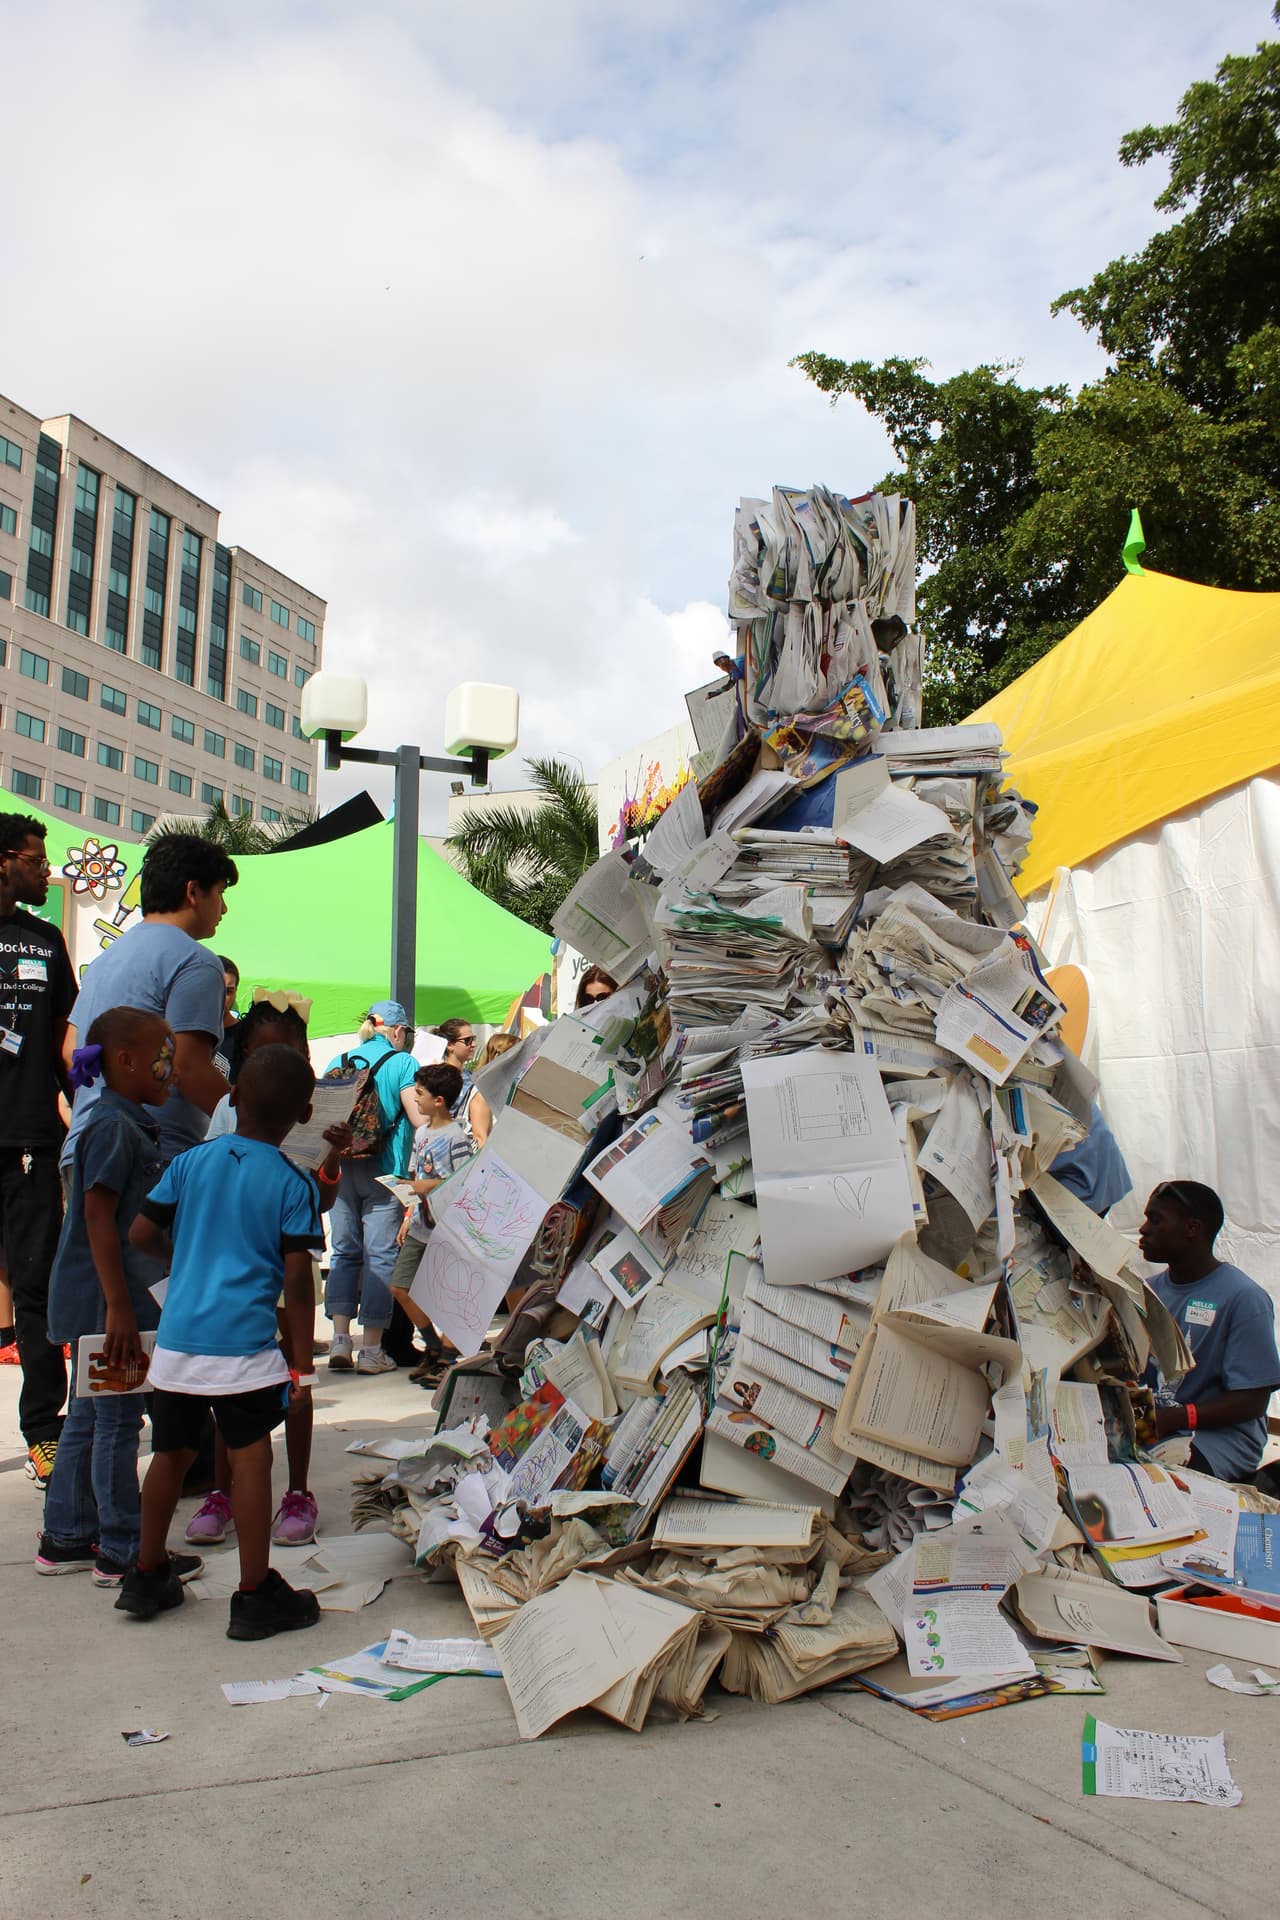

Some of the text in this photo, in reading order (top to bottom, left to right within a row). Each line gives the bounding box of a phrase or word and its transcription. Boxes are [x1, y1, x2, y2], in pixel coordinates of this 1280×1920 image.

[30, 944, 53, 958] Fair
[572, 956, 592, 980] ye
[22, 983, 47, 993] College
[1192, 1300, 1214, 1309] HELLO
[1264, 1527, 1273, 1570] Chemistry
